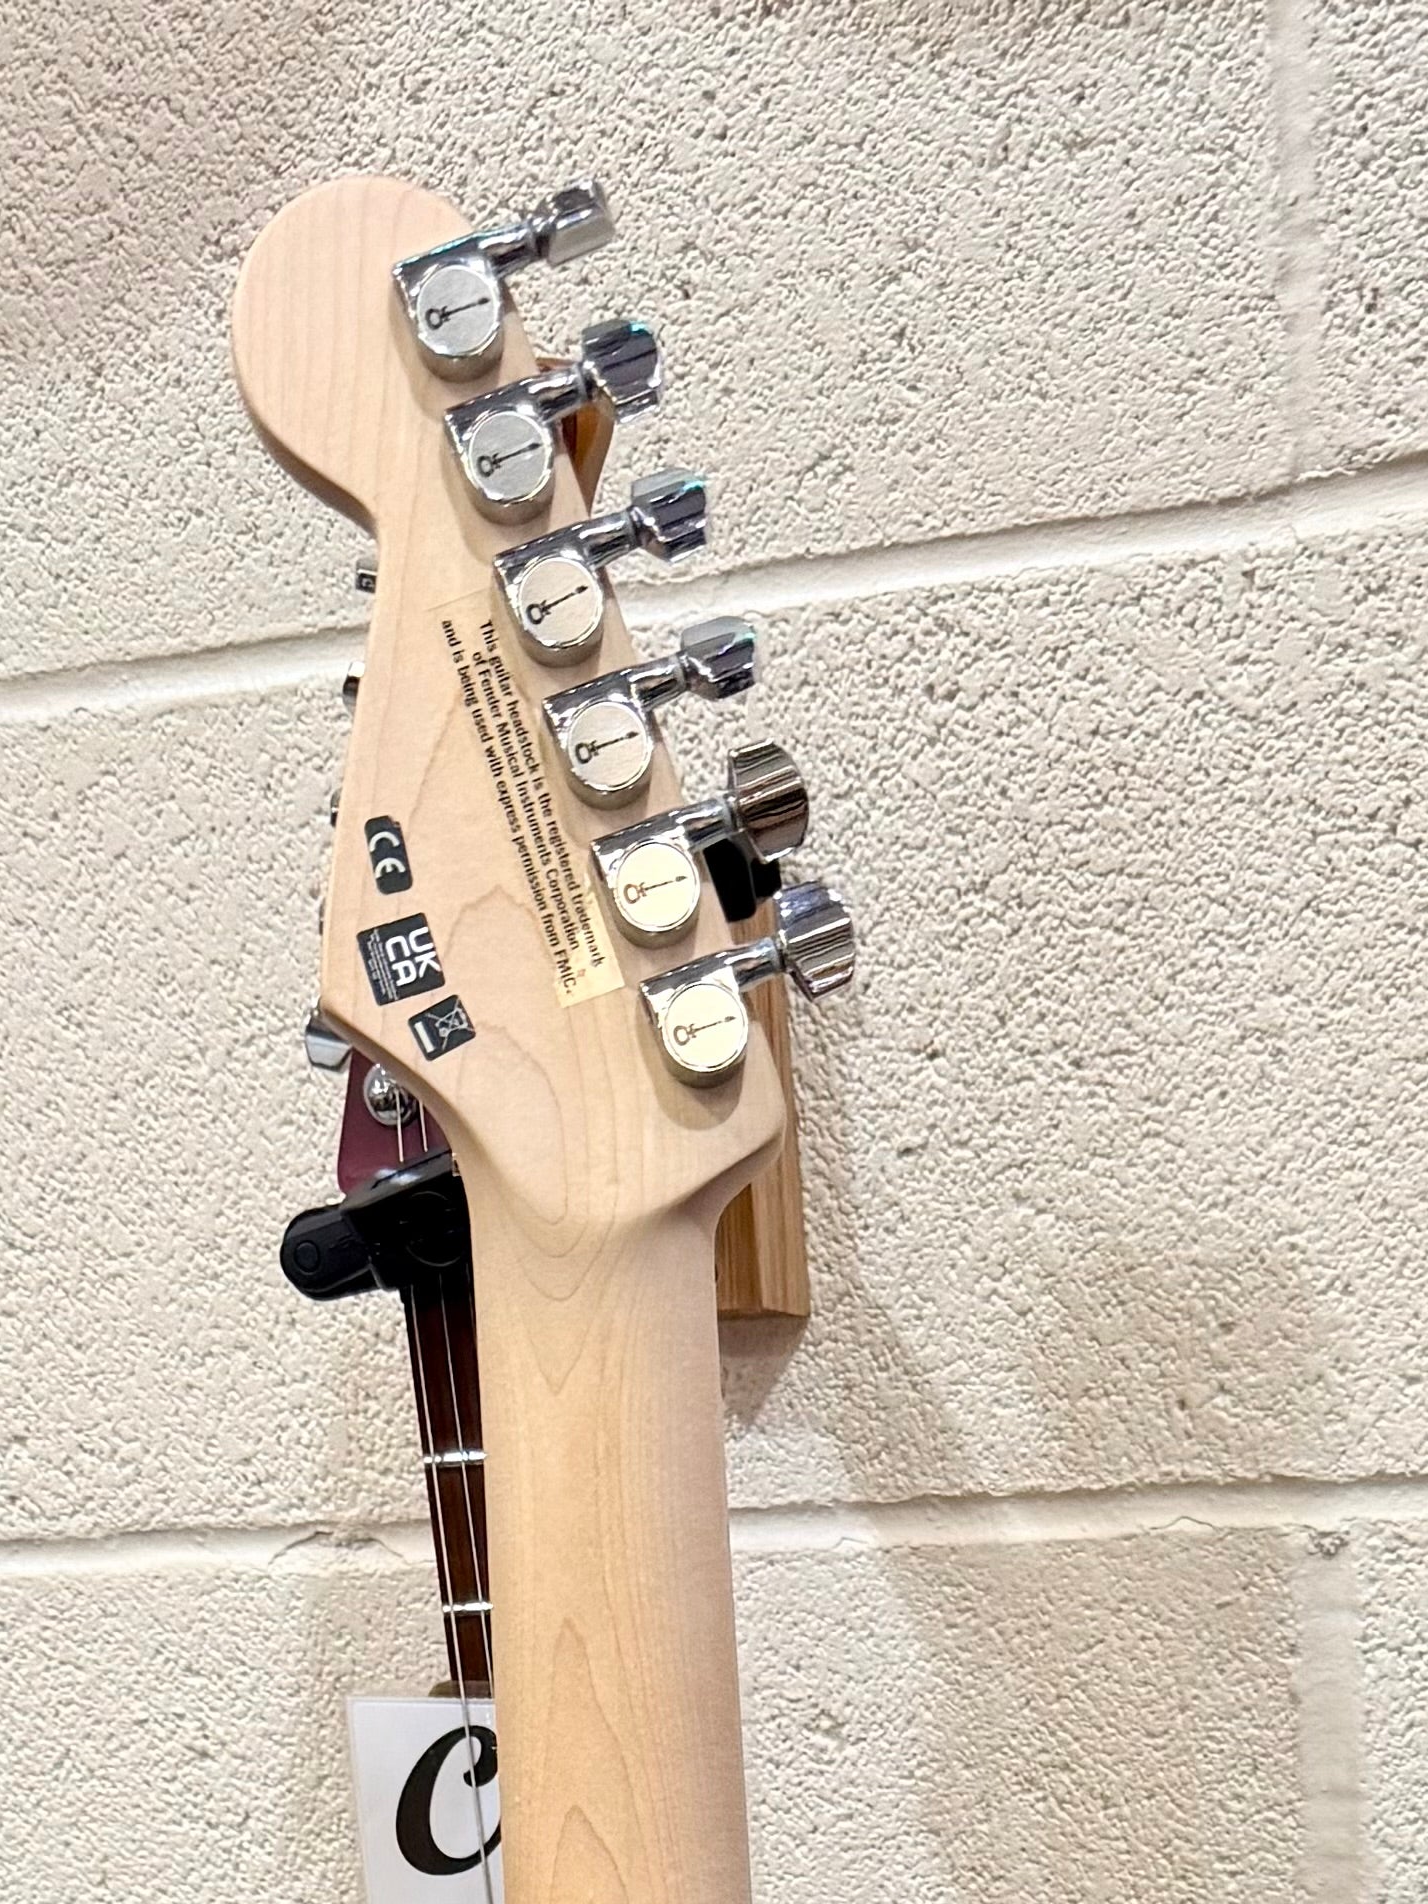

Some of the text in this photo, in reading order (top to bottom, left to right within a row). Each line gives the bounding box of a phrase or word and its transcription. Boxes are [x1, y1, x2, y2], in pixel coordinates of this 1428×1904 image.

[480, 620, 498, 652] This
[488, 656, 512, 696] guitar
[507, 700, 540, 774] headstock
[442, 621, 576, 993] and is being used with express permission from FMIC.
[473, 652, 579, 950] of Fender Musical Instruments Corporation
[532, 777, 544, 790] is
[538, 793, 552, 817] the
[547, 821, 580, 891] registered
